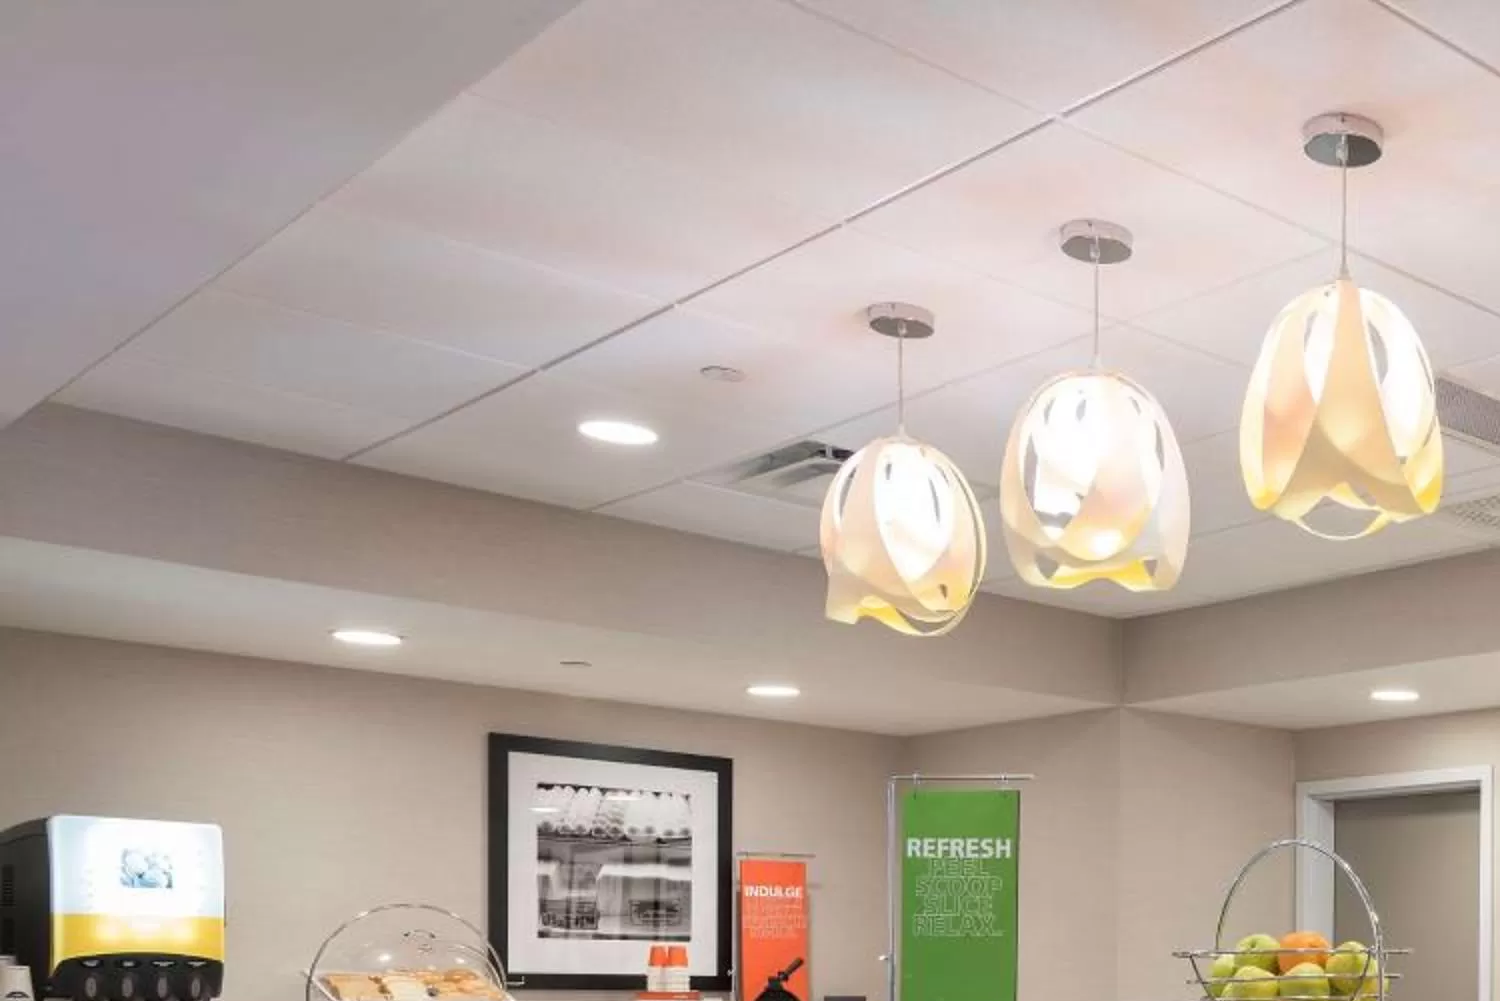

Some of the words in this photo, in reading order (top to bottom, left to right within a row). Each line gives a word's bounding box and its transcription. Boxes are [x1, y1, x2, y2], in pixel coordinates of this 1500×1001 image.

[907, 838, 1011, 859] REFRESH
[744, 884, 803, 897] INDULGE
[916, 876, 1003, 897] SCOOP
